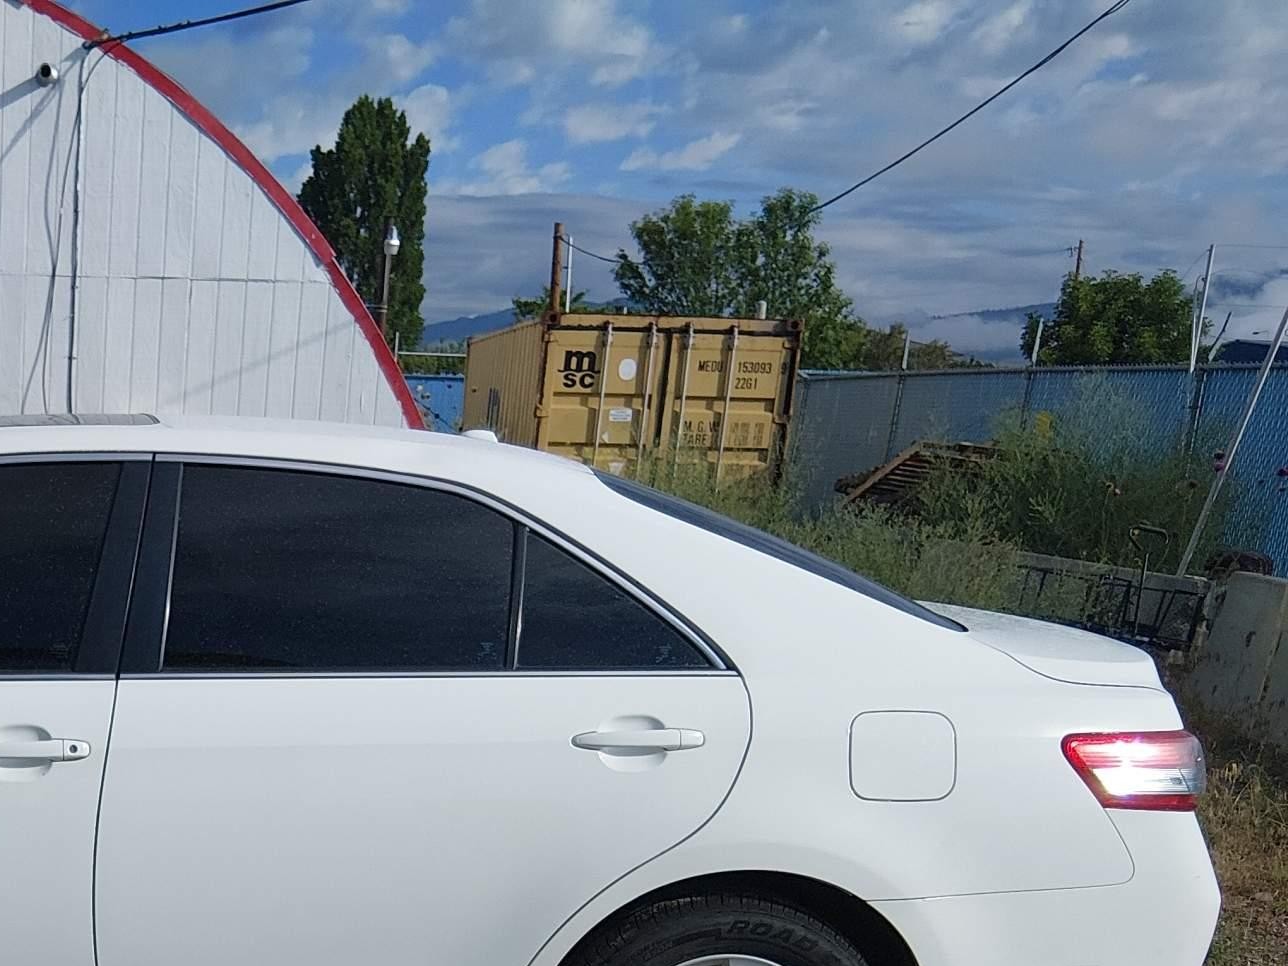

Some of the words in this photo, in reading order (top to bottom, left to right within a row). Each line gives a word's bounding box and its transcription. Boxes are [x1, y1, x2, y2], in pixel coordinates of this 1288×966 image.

[697, 360, 724, 373] MEDU
[737, 361, 772, 374] 153093
[734, 377, 758, 390] 22G1
